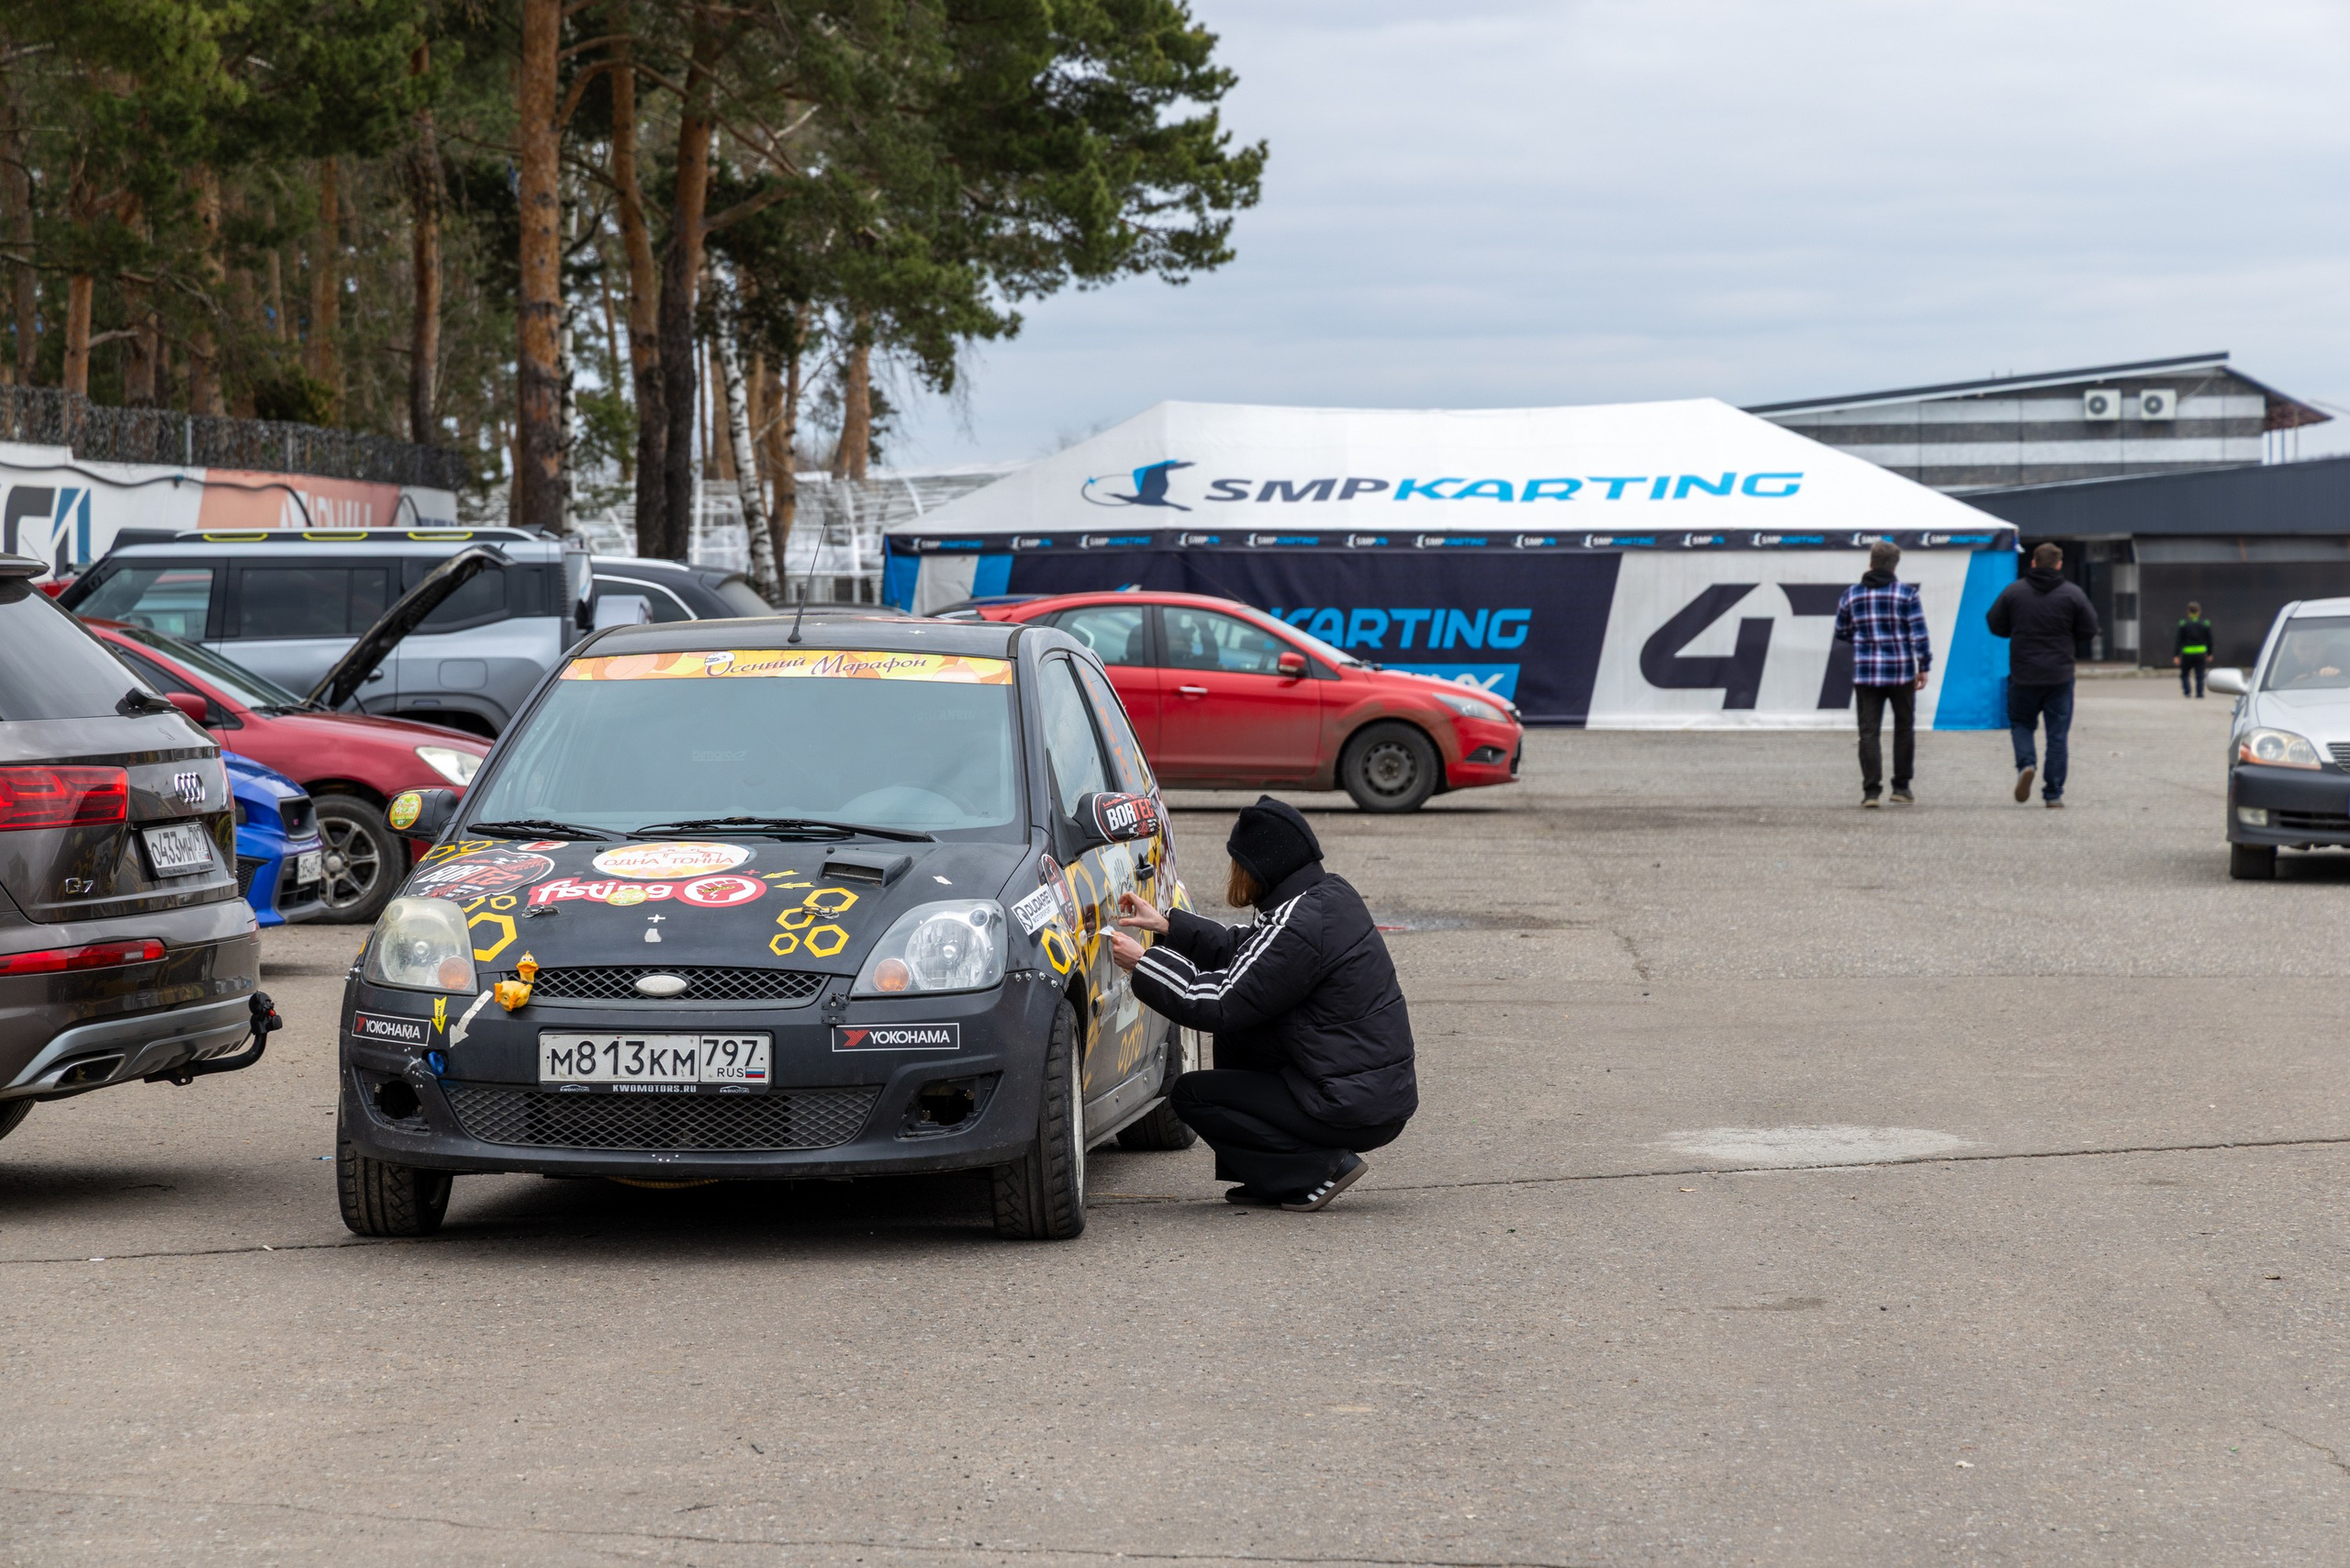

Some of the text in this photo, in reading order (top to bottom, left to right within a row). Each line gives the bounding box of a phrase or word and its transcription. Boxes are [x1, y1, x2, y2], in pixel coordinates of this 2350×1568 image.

[811, 654, 926, 676] Марафон
[1105, 798, 1155, 832] BORTEC
[603, 857, 734, 866] ОДНА ТОННА
[65, 877, 94, 894] Q7
[365, 1019, 420, 1039] YOKOHAMA
[869, 1030, 950, 1044] YOKOHAMA
[703, 1039, 758, 1066] 797
[717, 1068, 744, 1078] RUS
